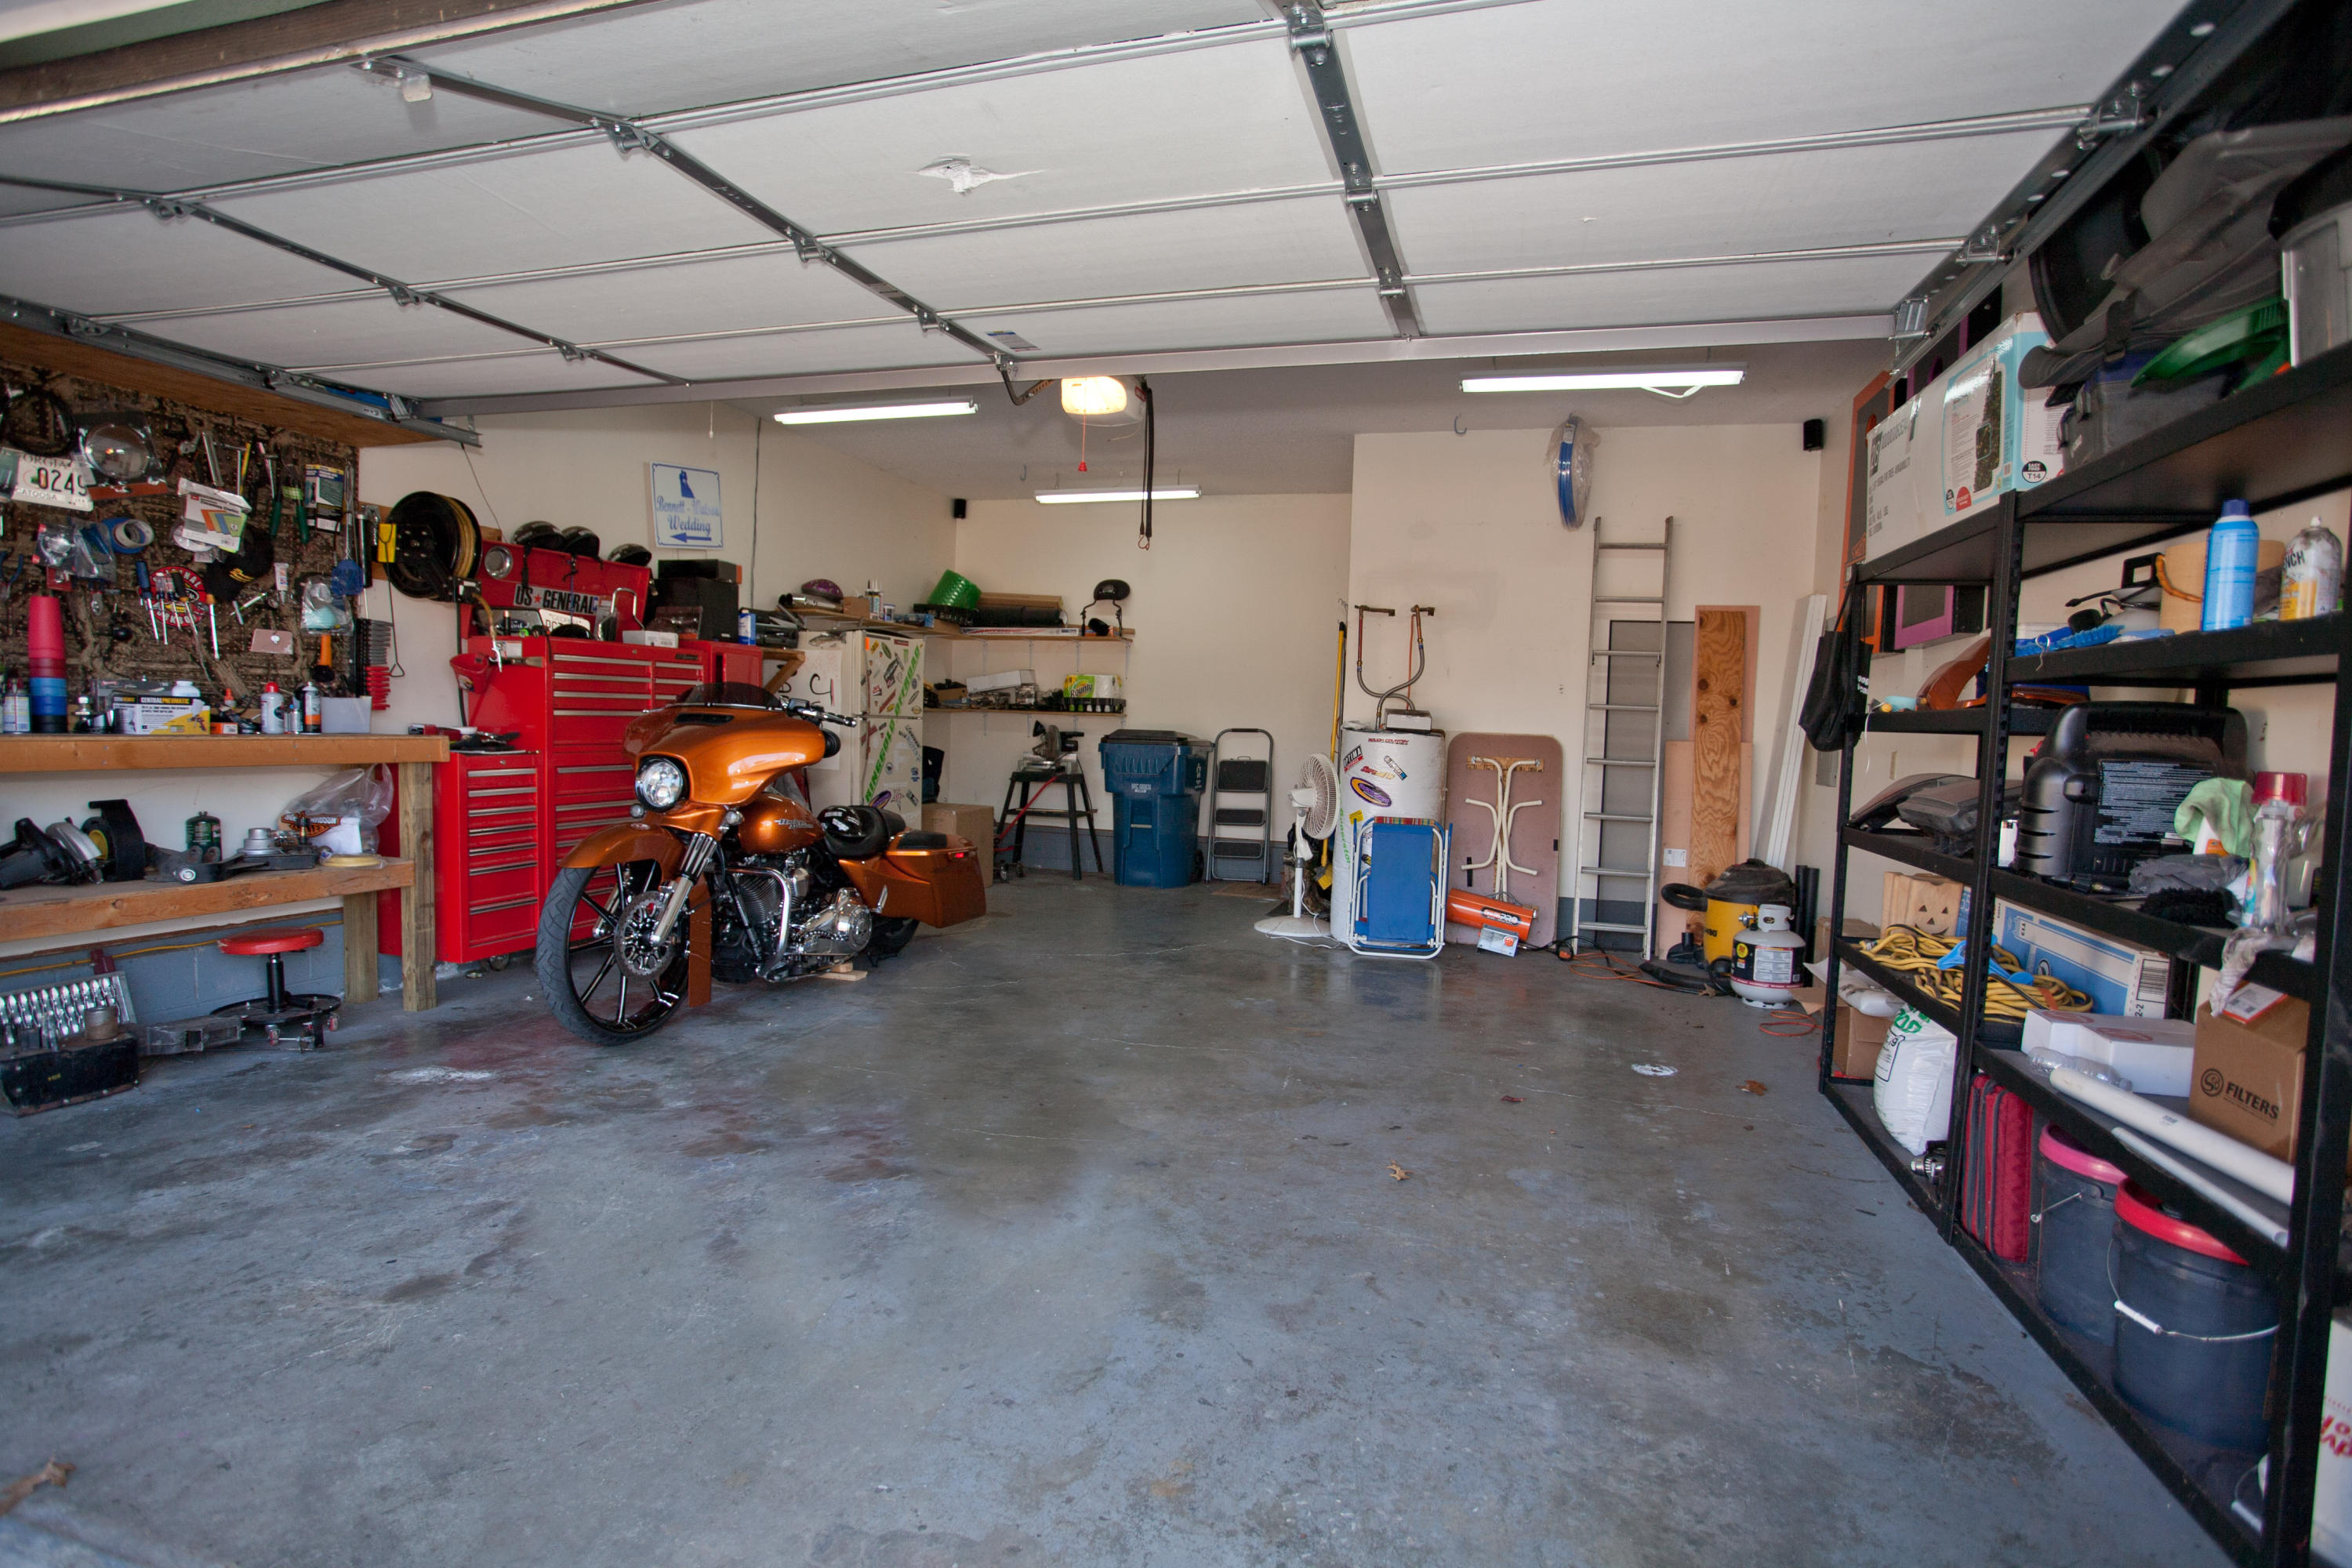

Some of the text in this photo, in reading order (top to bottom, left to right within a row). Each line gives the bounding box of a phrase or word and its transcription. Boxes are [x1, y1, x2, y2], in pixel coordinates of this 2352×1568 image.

[667, 514, 710, 536] Wedding
[514, 585, 594, 615] US GENERAL
[1070, 683, 1093, 698] Bounty
[2225, 1081, 2281, 1120] FILTERS
